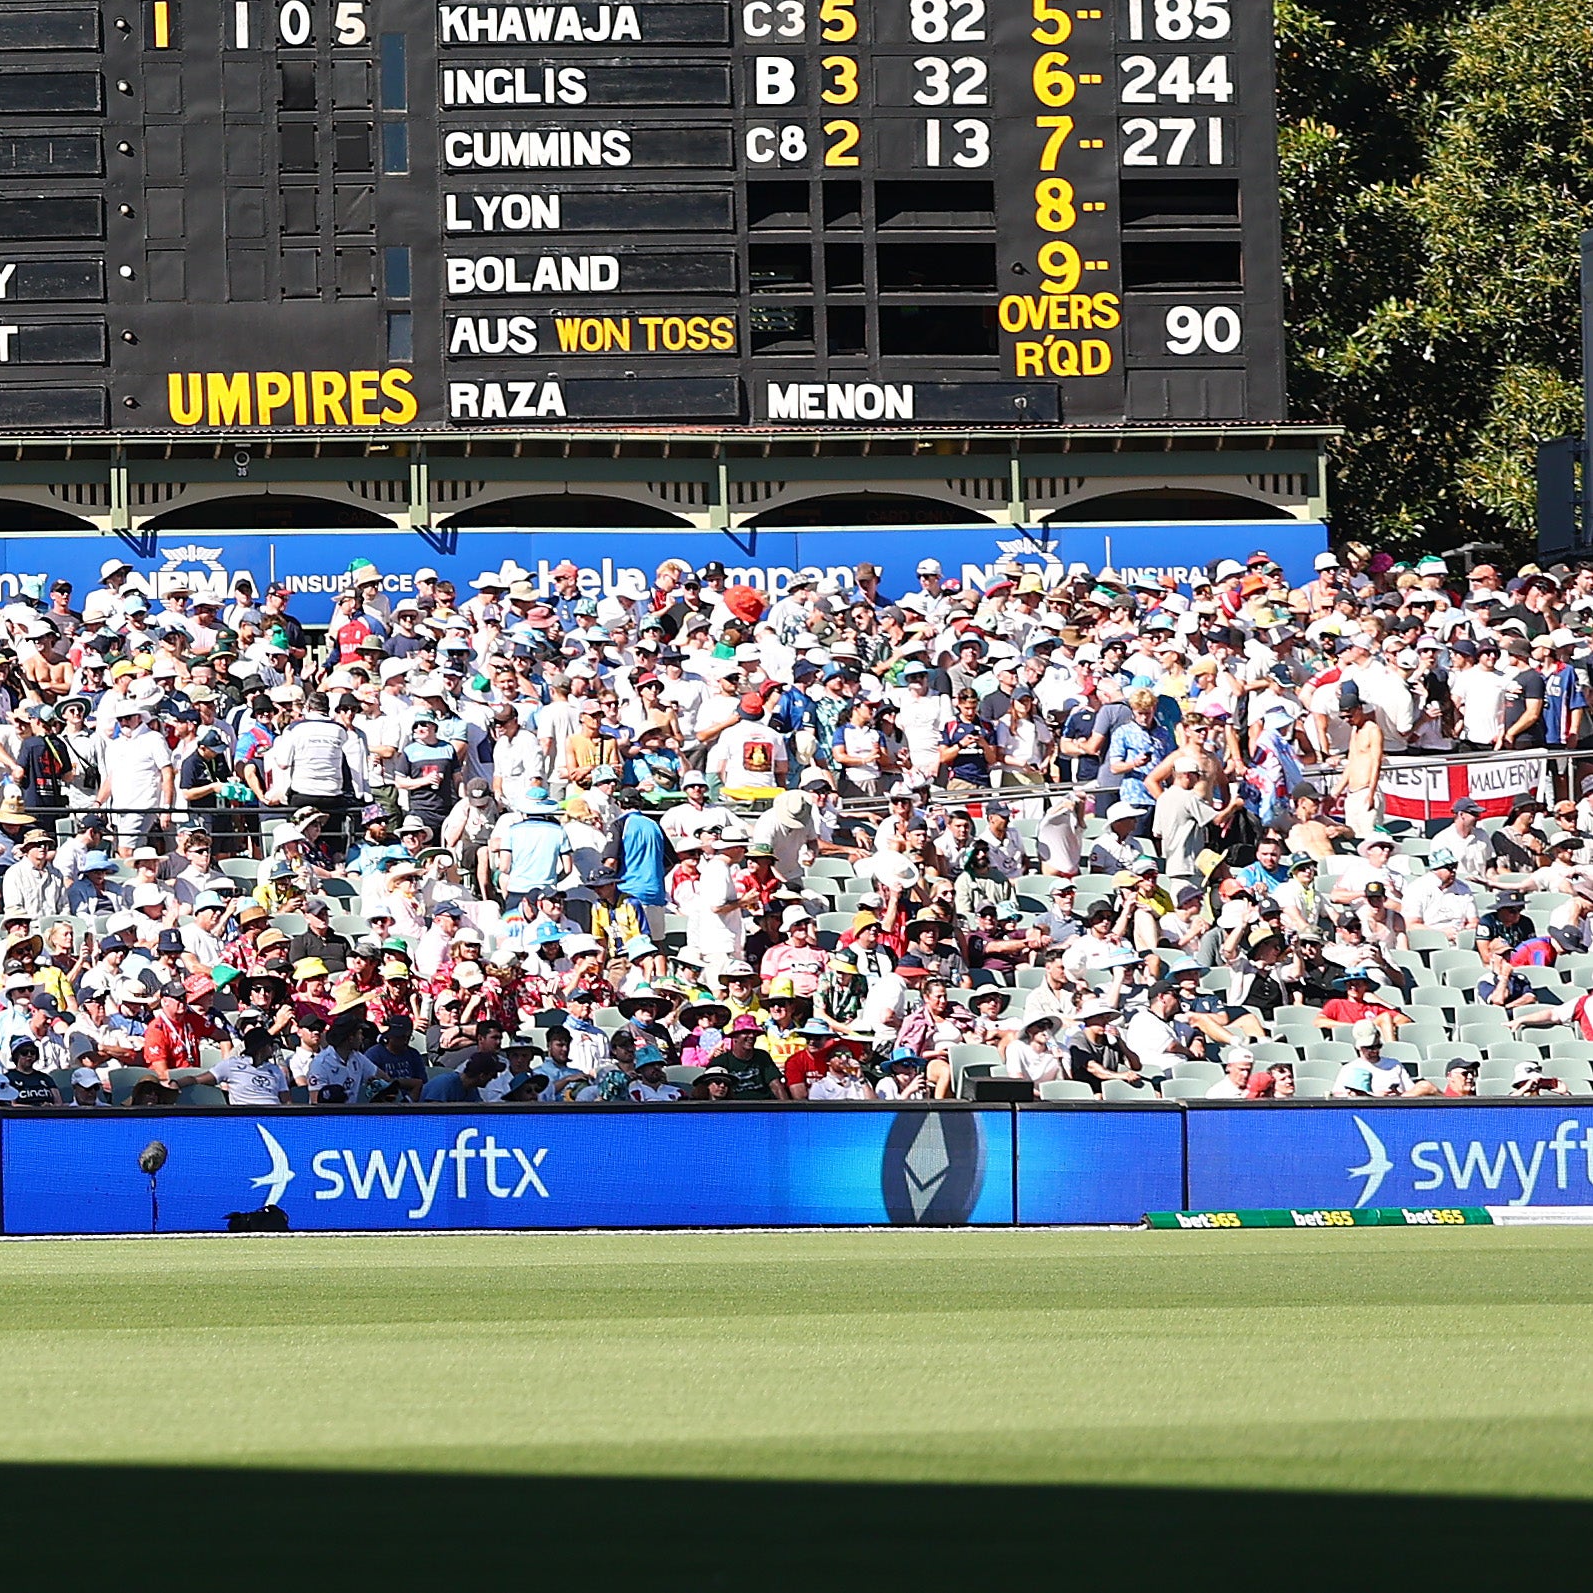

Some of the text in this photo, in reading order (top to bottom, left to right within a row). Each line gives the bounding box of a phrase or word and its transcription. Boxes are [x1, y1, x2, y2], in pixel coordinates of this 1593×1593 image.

[439, 5, 642, 42] KHAWAJA
[443, 54, 1233, 106] INGLIS 32 244
[444, 116, 1224, 169] CUMMINS 13 271
[445, 193, 560, 231] LYON
[446, 253, 620, 294] BOLAND
[449, 315, 735, 354] AUS WON TOSS
[997, 291, 1241, 356] OVERS 90
[167, 368, 419, 429] UMPIRES
[449, 381, 567, 418] RAZA
[768, 382, 914, 420] MENON
[1470, 762, 1542, 793] MALVERN
[19, 1088, 53, 1099] cinch
[312, 1128, 549, 1219] swyftx
[1176, 1213, 1241, 1228] bet365
[1291, 1211, 1354, 1226] bet365
[1402, 1209, 1465, 1225] bet365
